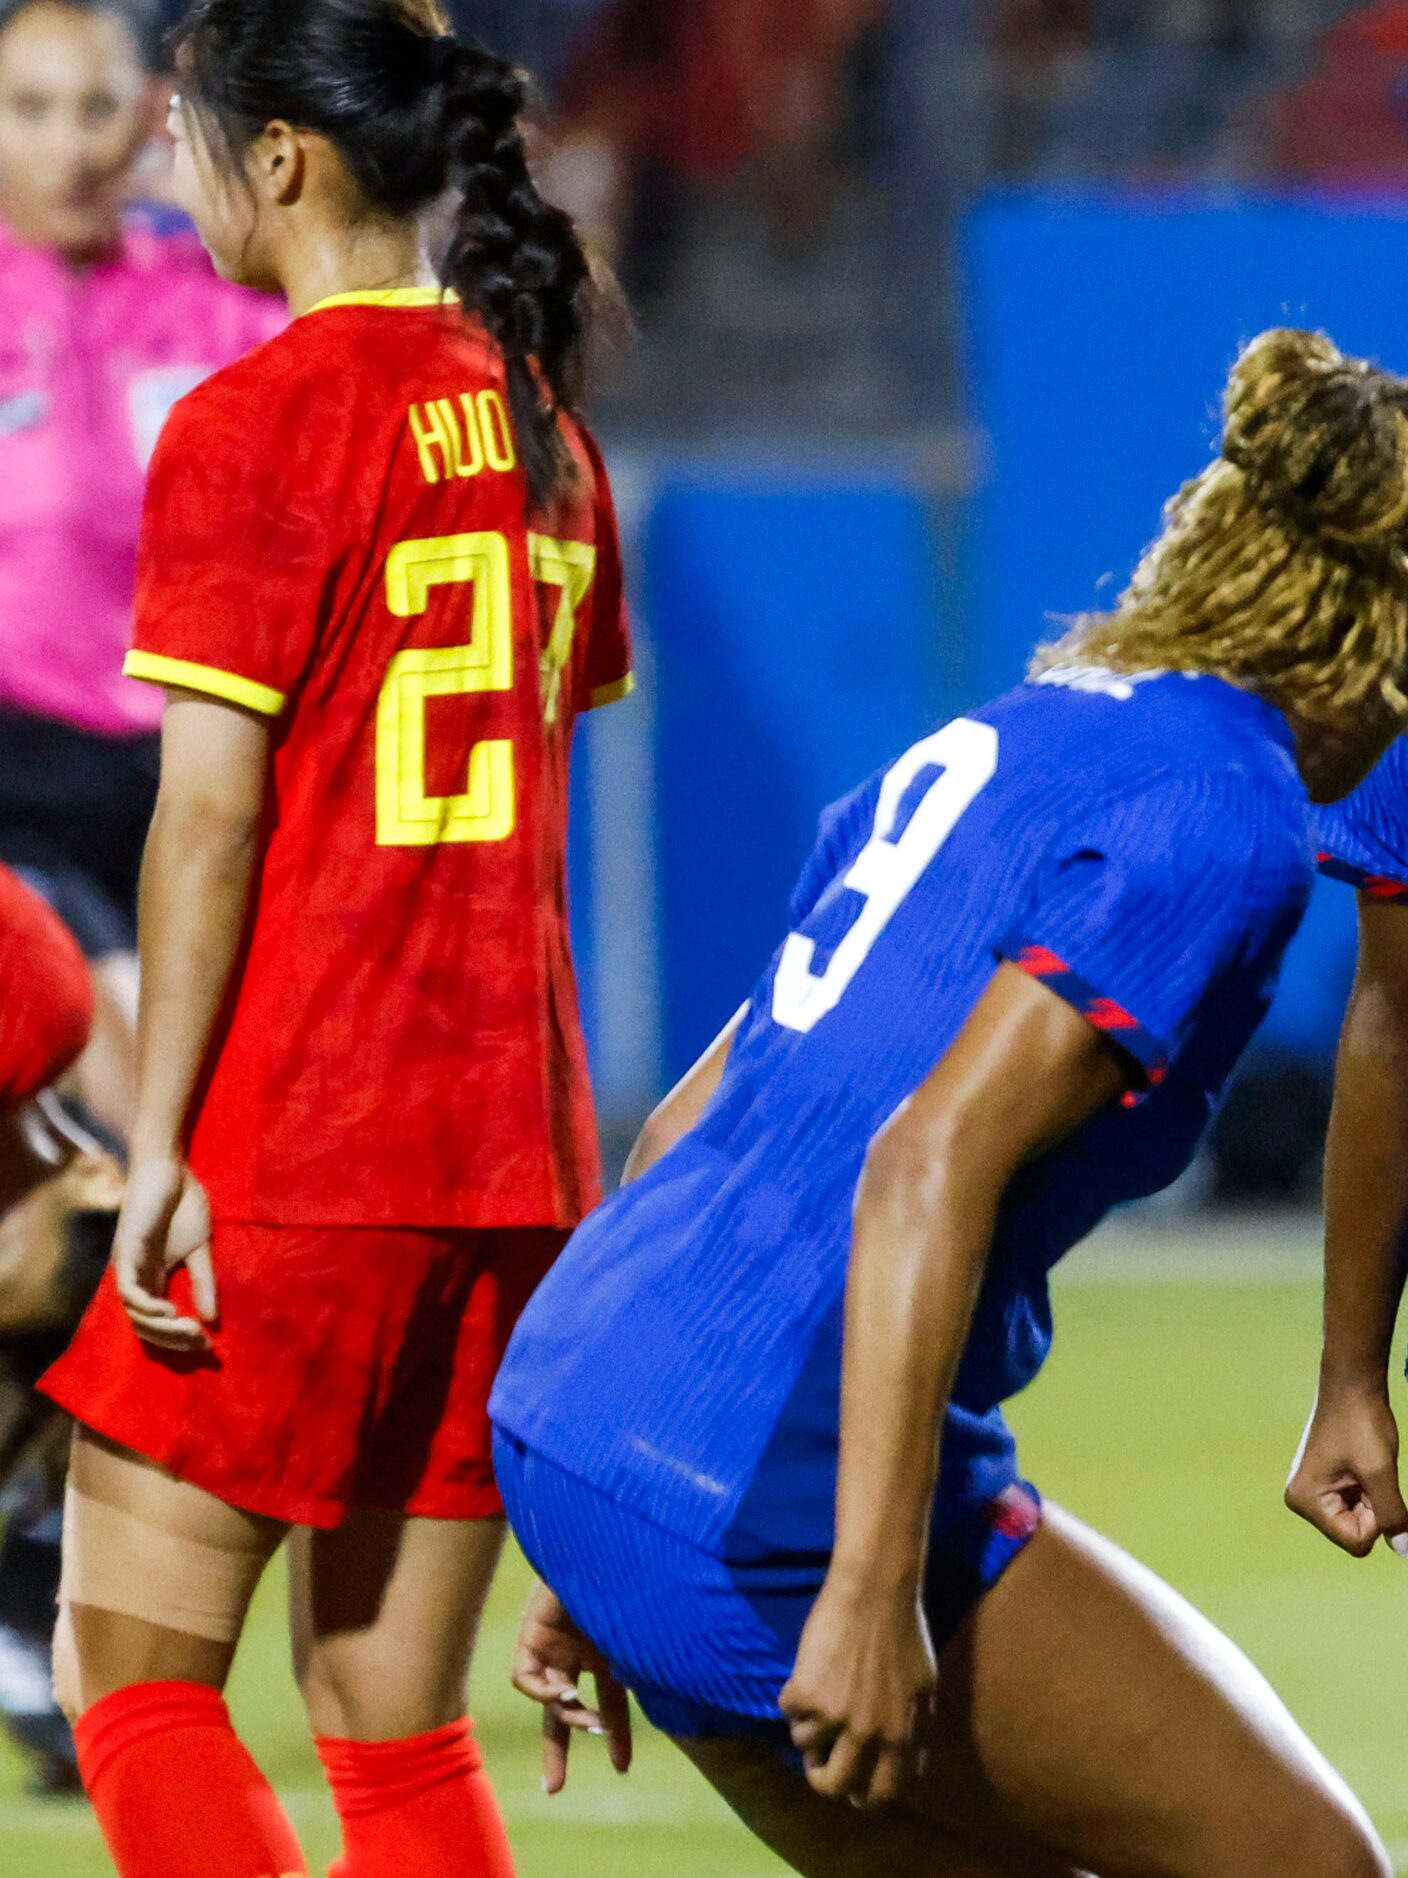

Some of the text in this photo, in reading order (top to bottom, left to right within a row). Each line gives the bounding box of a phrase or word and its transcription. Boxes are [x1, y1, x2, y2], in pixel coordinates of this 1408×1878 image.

[408, 389, 516, 484] HUO
[375, 530, 597, 846] 27
[772, 717, 999, 1033] 9
